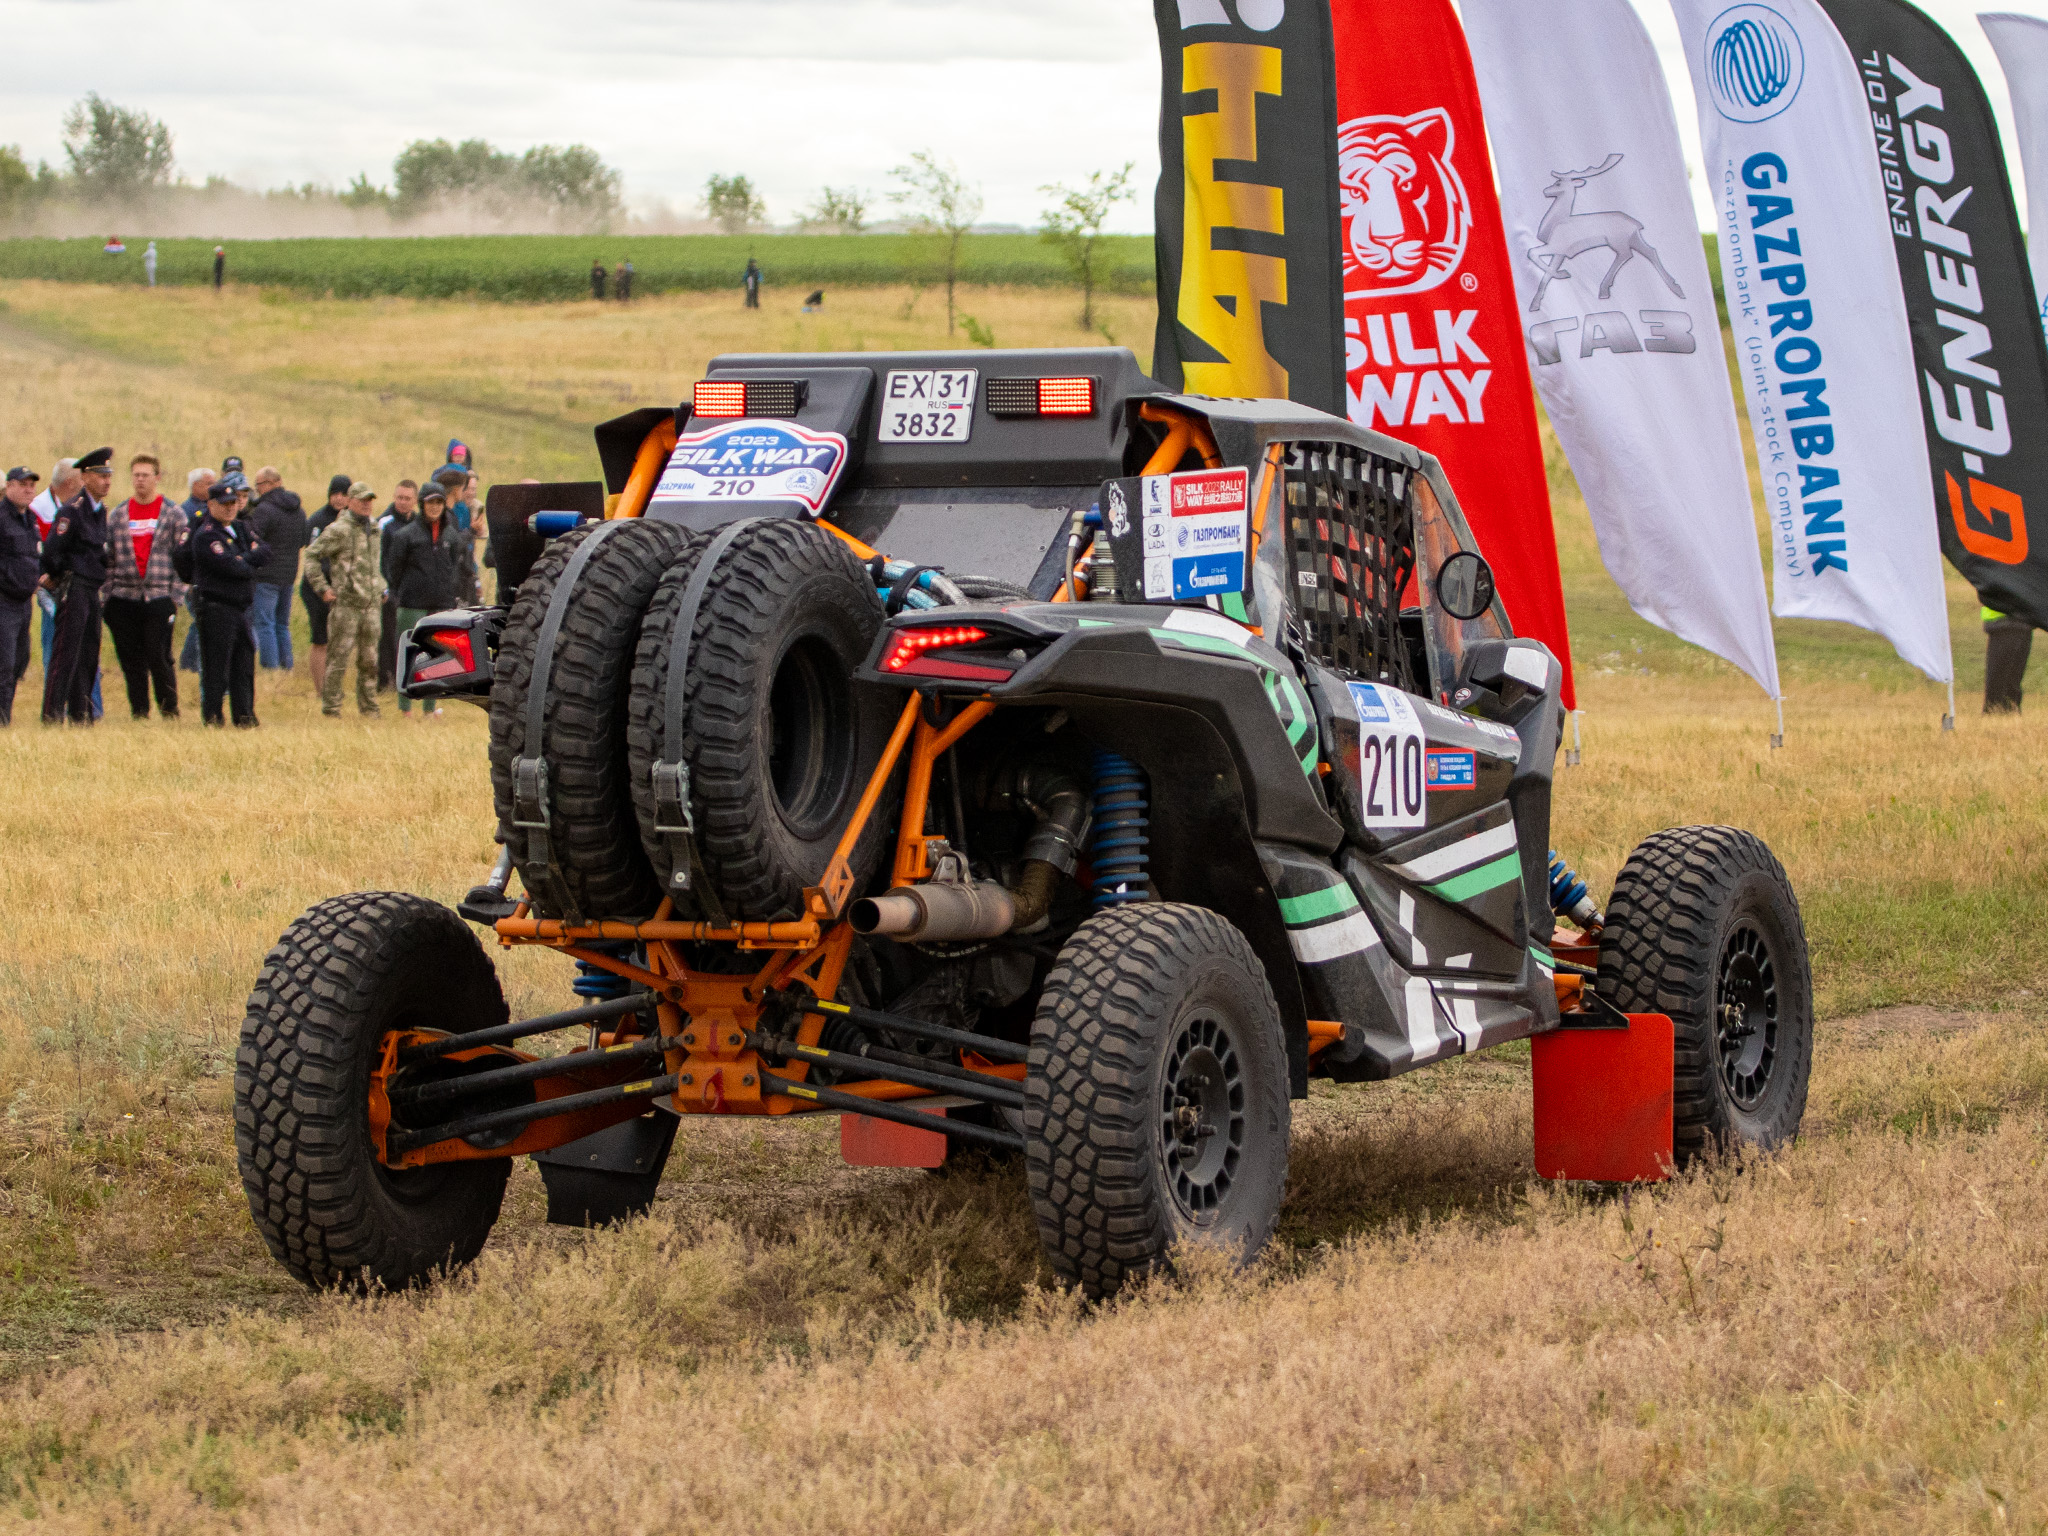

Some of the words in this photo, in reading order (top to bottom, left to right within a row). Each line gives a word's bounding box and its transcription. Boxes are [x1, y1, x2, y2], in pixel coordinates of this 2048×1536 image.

[1862, 50, 1887, 104] OIL
[1873, 111, 1912, 238] ENGINE
[1887, 53, 2029, 565] G-ENERGY
[1344, 310, 1491, 371] SILK
[1528, 310, 1697, 366] ГАЗ
[1741, 152, 1848, 577] GAZPROMBANK
[890, 374, 929, 398] EX
[937, 374, 969, 398] 31
[927, 401, 948, 409] RUS
[1346, 369, 1492, 428] WAY
[892, 413, 956, 437] 3832
[727, 435, 779, 446] 2023
[670, 448, 750, 466] SILK
[751, 448, 831, 465] WAY
[1744, 336, 1785, 463] (Joint-stock
[1774, 471, 1805, 577] Company)
[708, 466, 774, 475] RALLY
[708, 479, 755, 496] 210
[1185, 482, 1204, 495] SILK
[1204, 481, 1220, 494] 2023
[1220, 479, 1243, 492] RALLY
[1186, 494, 1204, 507] WAY
[1147, 540, 1165, 550] LADA
[1193, 525, 1240, 542] ГАЗПРОМБАНК
[1364, 734, 1422, 817] 210
